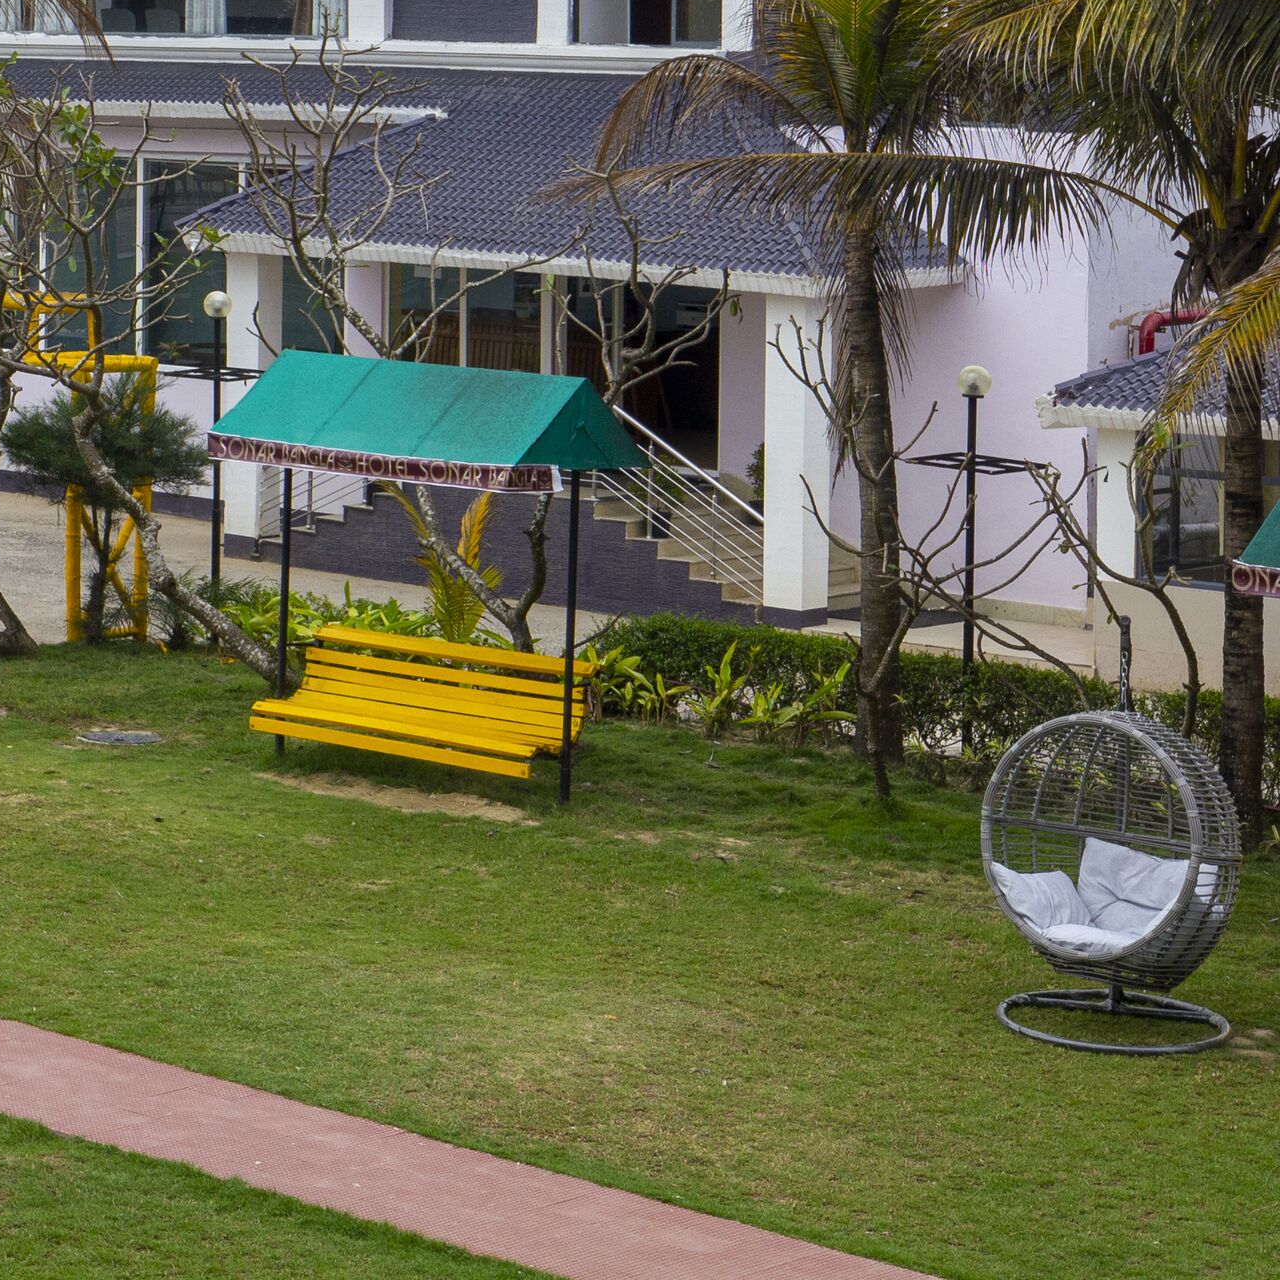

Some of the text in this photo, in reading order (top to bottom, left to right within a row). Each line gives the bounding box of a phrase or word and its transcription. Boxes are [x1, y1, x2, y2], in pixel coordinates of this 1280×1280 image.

[217, 436, 539, 488] SONAR BANGLA HOTEL SONAR BANGLA
